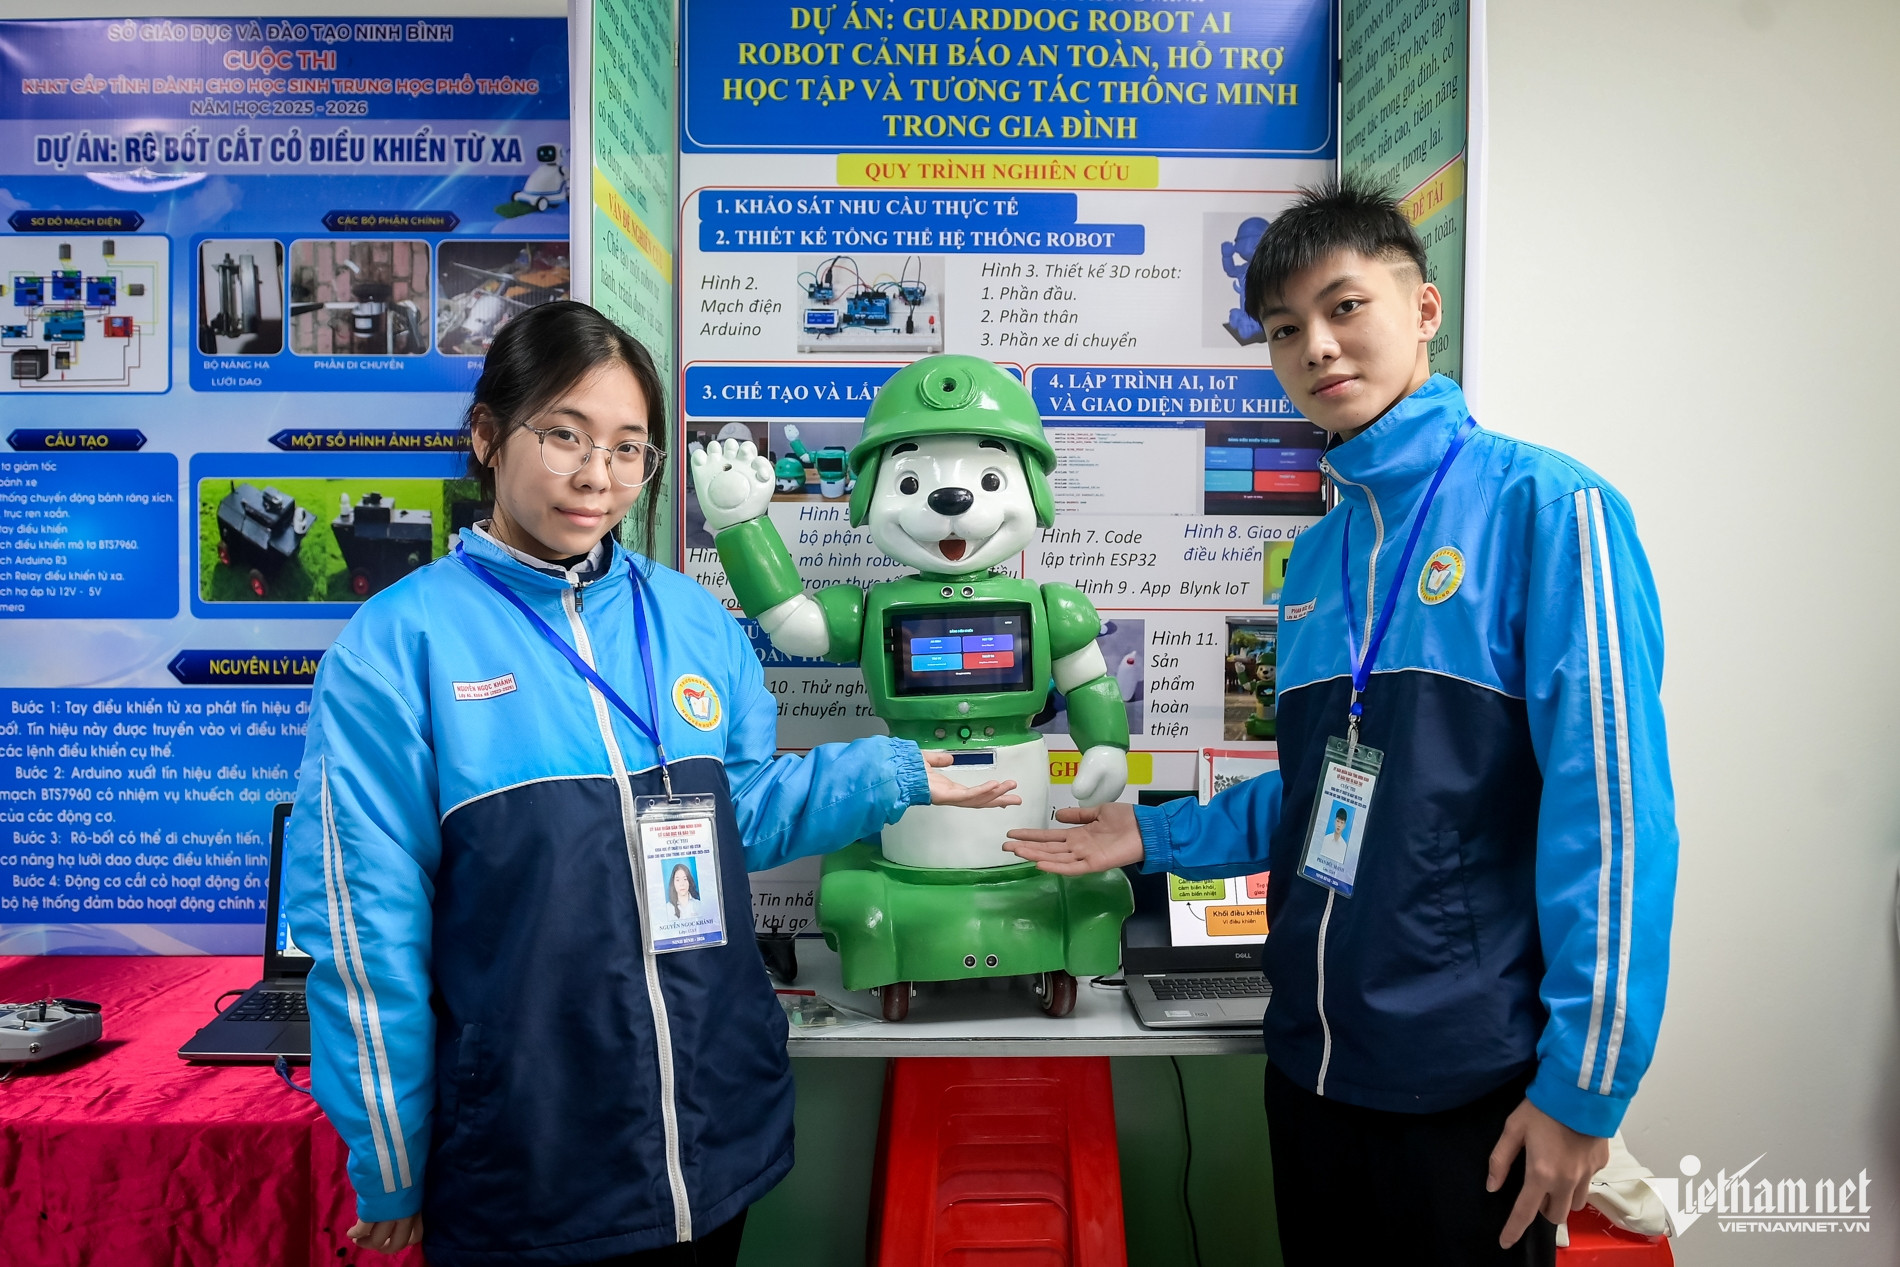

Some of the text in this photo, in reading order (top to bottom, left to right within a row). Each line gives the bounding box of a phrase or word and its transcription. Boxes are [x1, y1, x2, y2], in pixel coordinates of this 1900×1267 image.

[790, 0, 1232, 35] DỰ ÁN: GUARDDOG ROBOT AI
[109, 20, 453, 43] SỞ GIÁO DỤC VÀ ĐÀO TẠO NINH BÌNH
[223, 46, 337, 74] CUỘC THI
[738, 36, 1285, 76] ROBOT CẢNH BÁO AN TOÀN, HỖ TRỢ
[206, 73, 540, 98] CHO HỌC SINH TRUNG HỌC PHỔ THÔNG
[722, 72, 1298, 107] HỌC TẬP VÀ TƯƠNG TÁC THÔNG MINH
[191, 98, 229, 114] NĂM
[234, 101, 269, 118] HỌC
[273, 101, 314, 115] 2025
[327, 101, 367, 115] 2026
[883, 110, 1138, 139] TRONG GIA ĐÌNH
[36, 134, 72, 169] DỰ
[76, 130, 118, 163] ÁN:
[165, 128, 210, 163] BỐT
[217, 128, 263, 163] CẮT
[270, 128, 302, 163] CỎ
[309, 126, 366, 163] ĐIỀU
[373, 126, 446, 163] KHIỂN
[454, 131, 486, 163] TỪ
[491, 137, 522, 163] XA
[865, 158, 1130, 182] QUY TRÌNH NGHIÊN CỨU
[716, 194, 1019, 219] 1. KHẢO SÁT NHU CẦU THỰC TẾ
[715, 225, 1115, 250] 2. THIẾT KẾ TỔNG THỂ HỆ THỐNG ROBOT
[980, 262, 1182, 280] Hình 3. Thiết kế 3D robot:
[701, 275, 758, 290] Hình 2.
[700, 299, 782, 316] Mạch điện
[700, 322, 762, 337] Arduino
[1049, 370, 1238, 393] 4. LẬP TRÌNH AI, IoT
[702, 380, 841, 404] 3. CHẾ TẠO VÀ
[1049, 393, 1236, 416] VÀ GIAO DIỆN ĐIỀU
[45, 431, 109, 450] CẤU TẠO
[290, 431, 453, 450] MỘT SỐ HÌNH ẢNH SẢN
[1041, 529, 1142, 544] Hình 7. Code
[1041, 551, 1157, 569] lập trình ESP32
[1151, 631, 1218, 646] Hình 11.
[209, 655, 291, 675] NGUYÊN LÝ
[1151, 652, 1179, 668] Sản
[1150, 674, 1195, 693] phẩm
[11, 698, 291, 717] Bước 1: Tay điều khiển từ xa phát tín hiệu
[1150, 699, 1189, 713] hoàn
[1150, 721, 1189, 738] thiện
